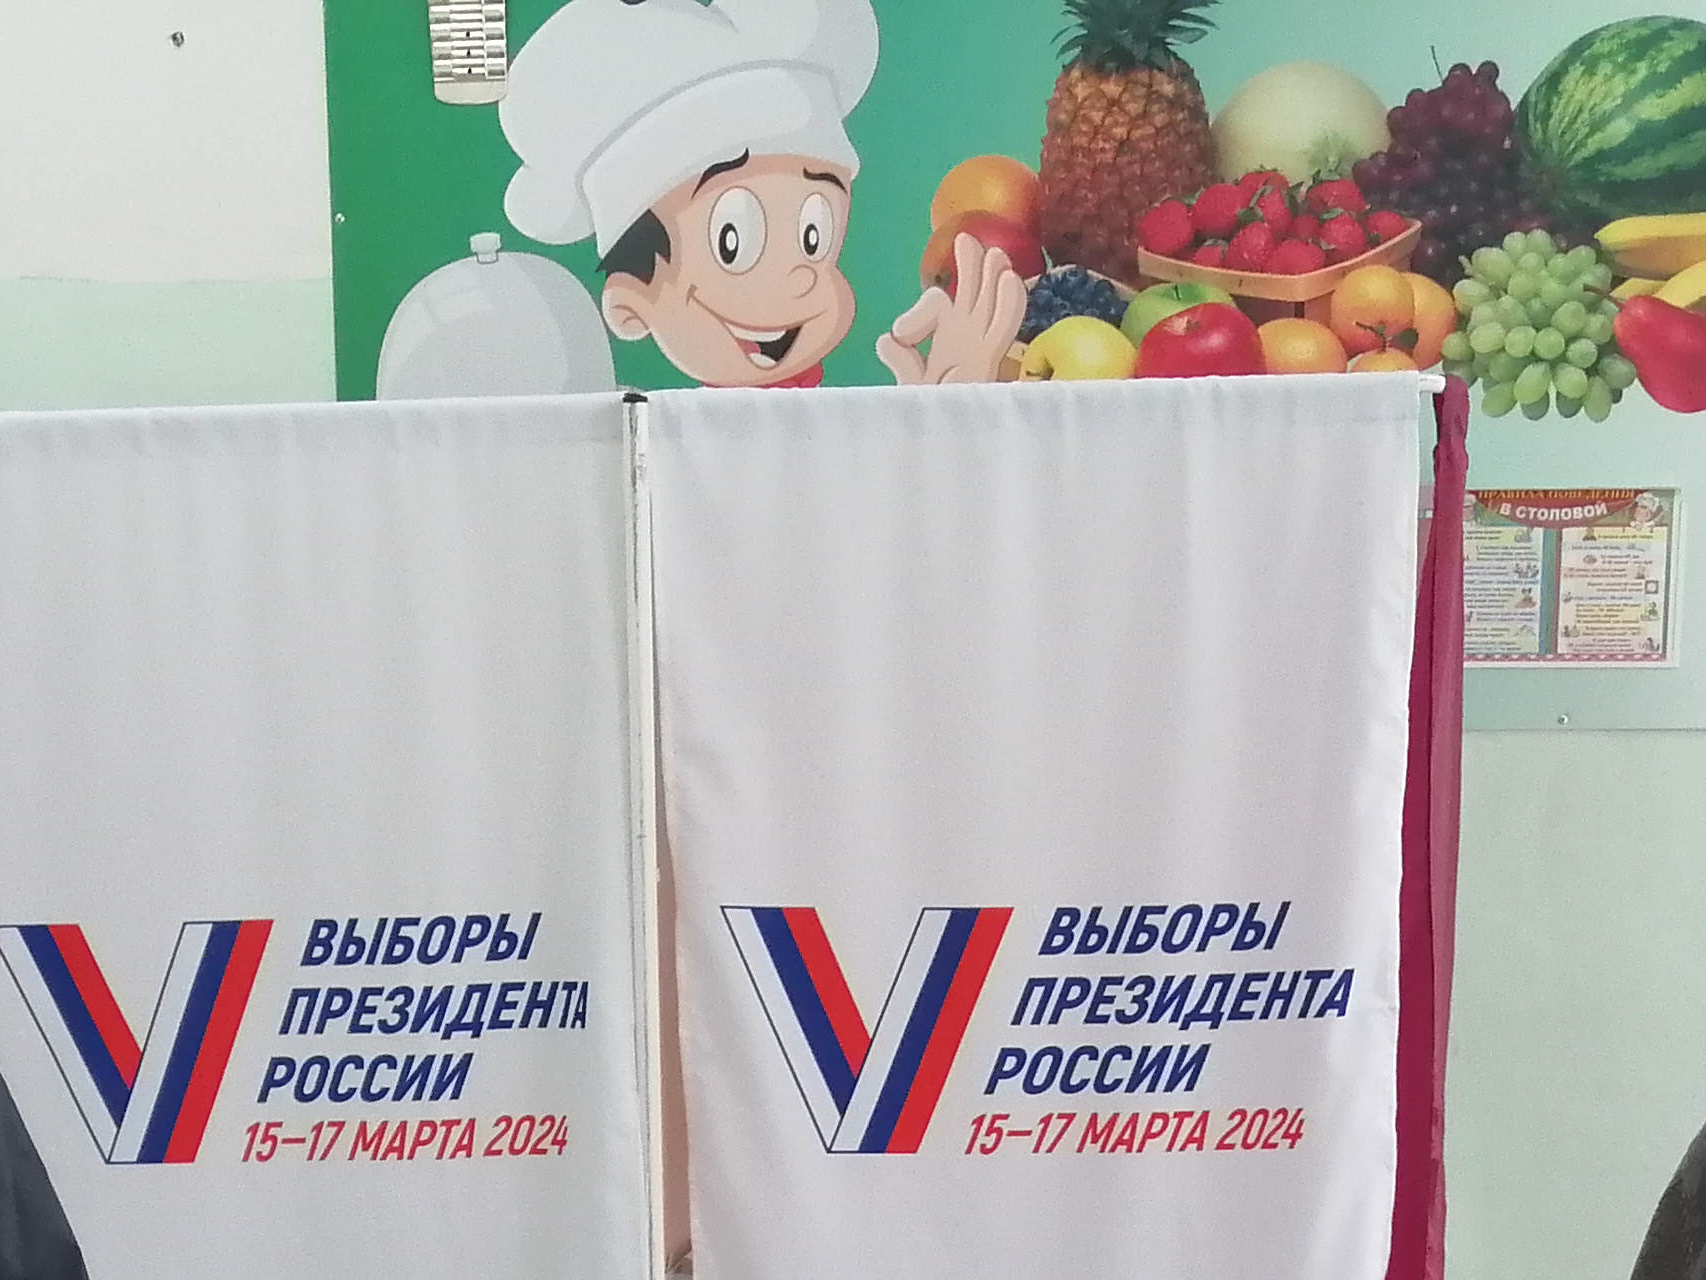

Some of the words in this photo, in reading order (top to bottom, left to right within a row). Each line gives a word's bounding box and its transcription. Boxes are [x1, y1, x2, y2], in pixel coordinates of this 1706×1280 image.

[1499, 502, 1510, 516] В
[1515, 501, 1609, 521] СТОЛОВОЙ
[300, 912, 542, 967] ВЫБОРЫ
[1038, 901, 1292, 957] ВЫБОРЫ
[279, 980, 590, 1041] ПРЕЗИДЕНТА
[1010, 968, 1356, 1030] ПРЕЗИДЕНТА
[257, 1053, 474, 1104] РОССИИ
[984, 1043, 1212, 1096] РОССИИ
[348, 1117, 477, 1162] МАРТА
[483, 1114, 570, 1158] 2024
[1076, 1110, 1211, 1154] МАРТА
[1214, 1107, 1304, 1152] 2024
